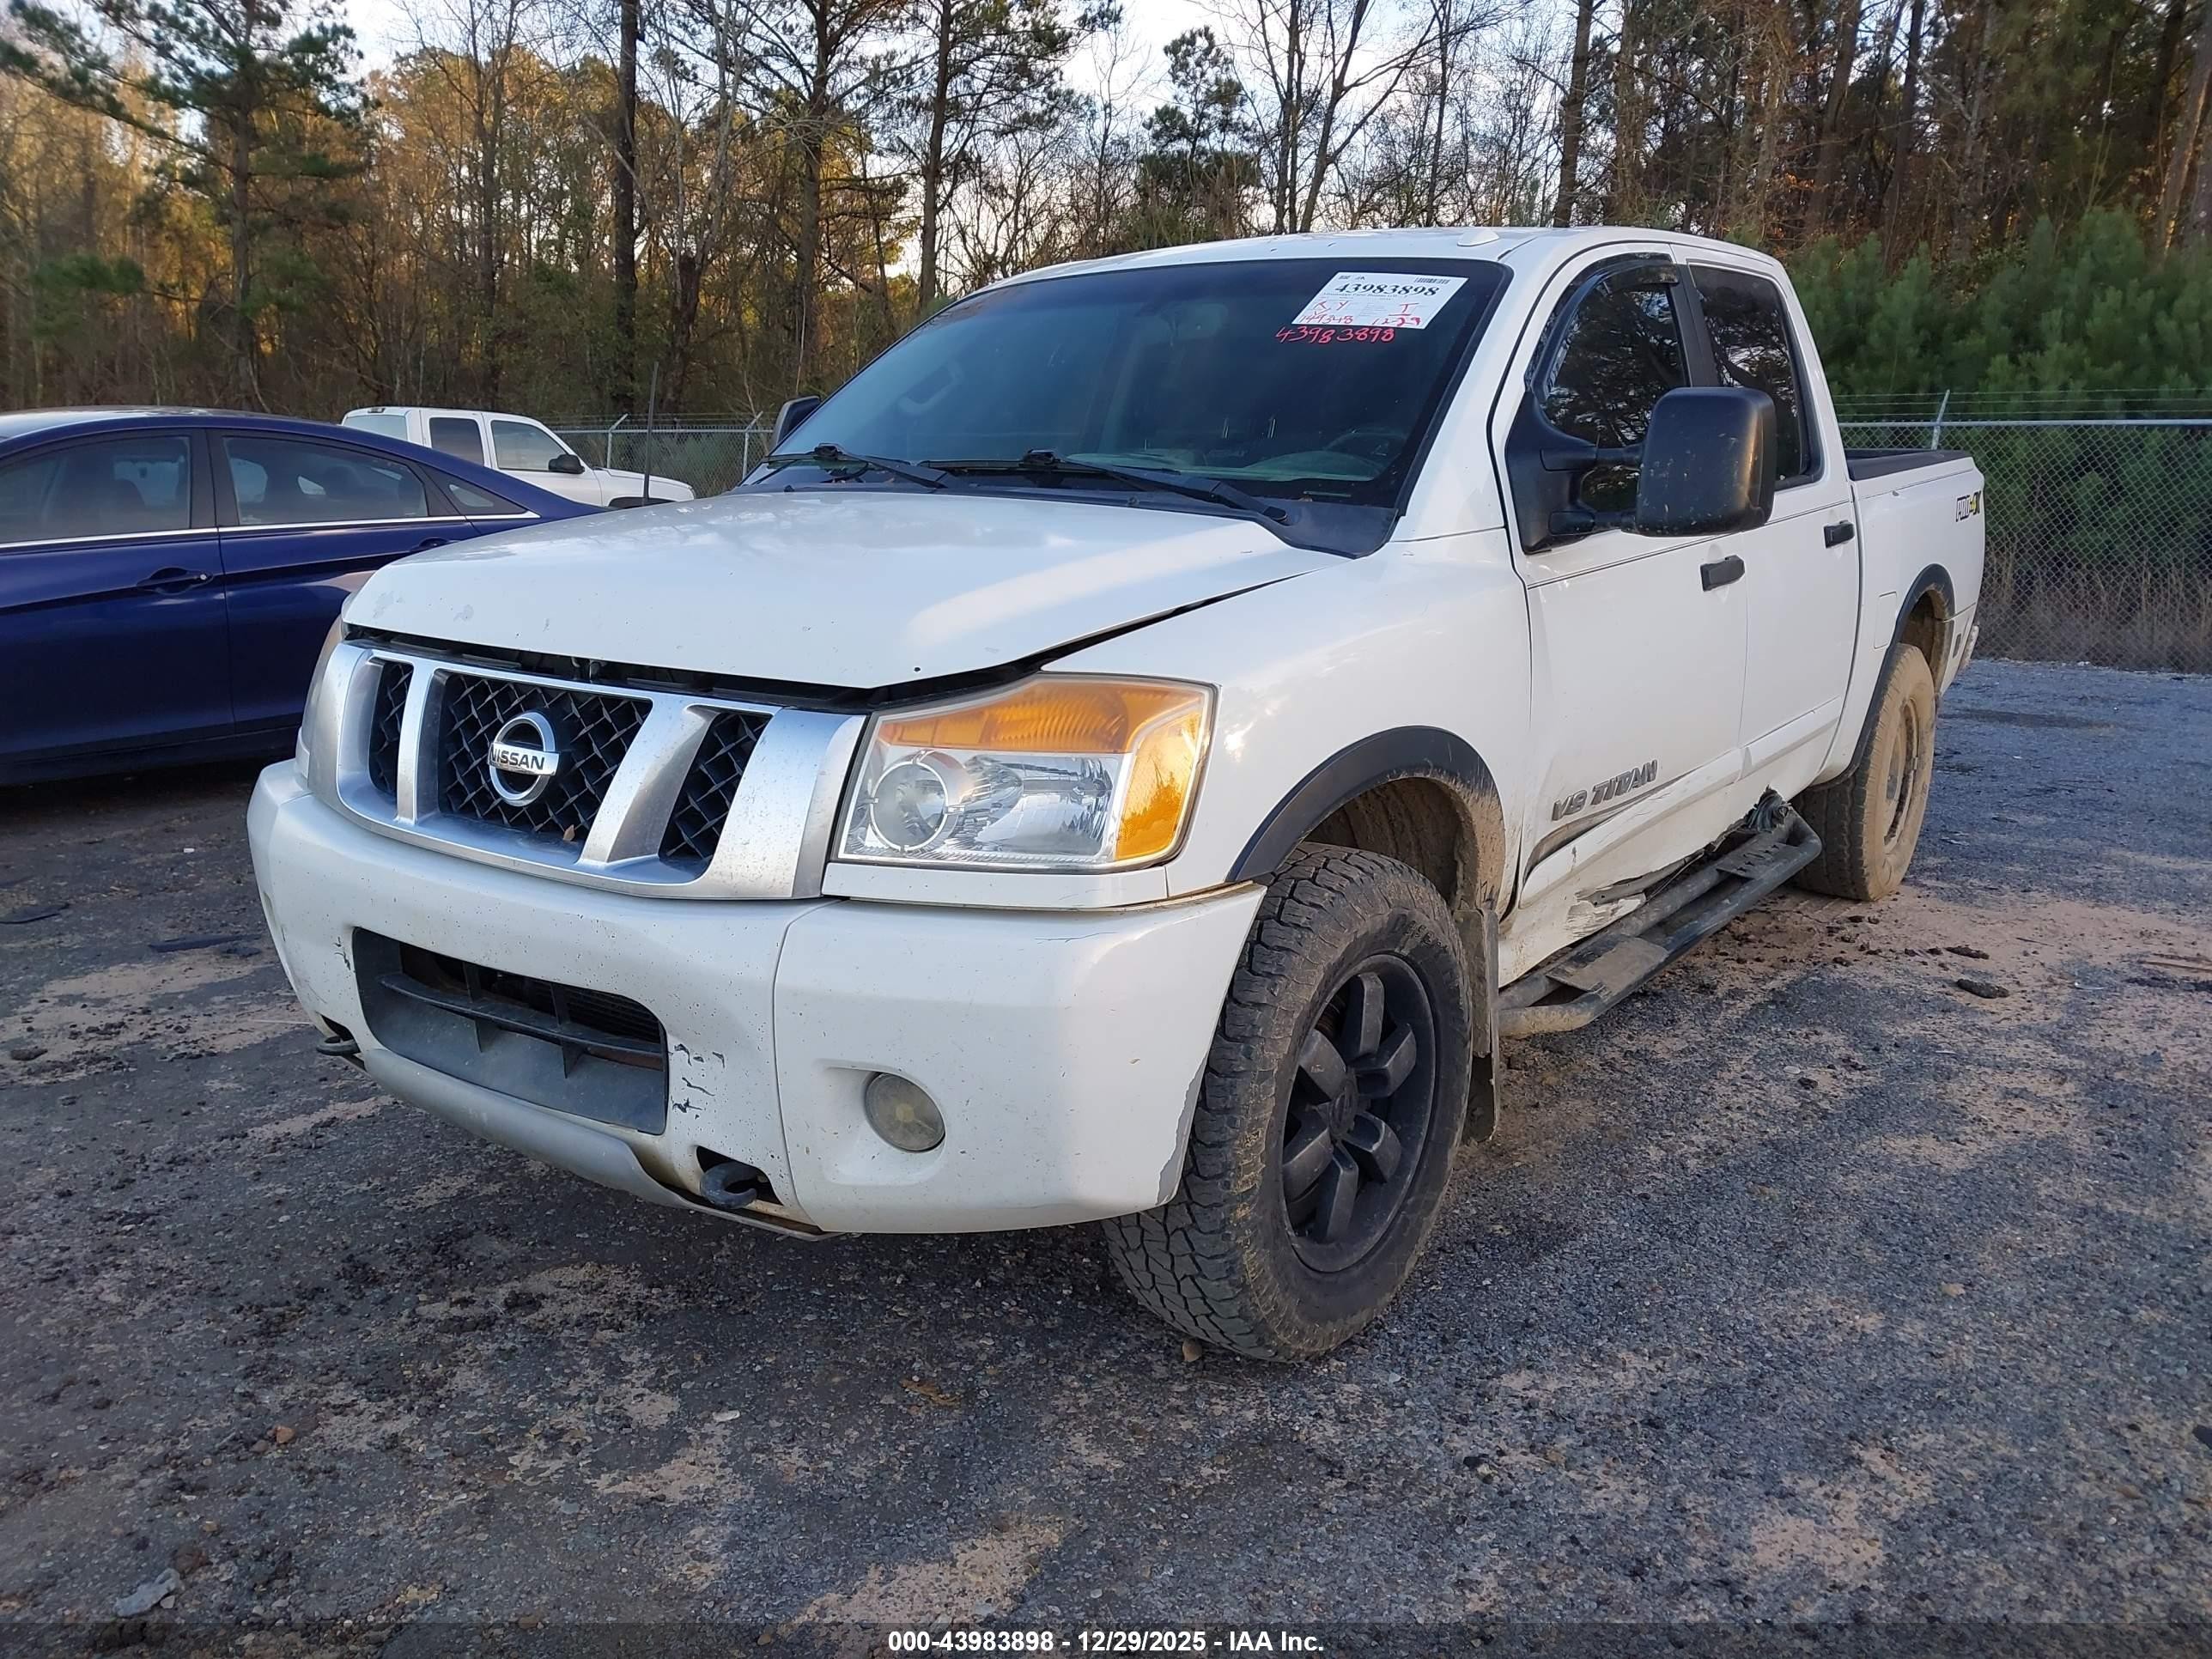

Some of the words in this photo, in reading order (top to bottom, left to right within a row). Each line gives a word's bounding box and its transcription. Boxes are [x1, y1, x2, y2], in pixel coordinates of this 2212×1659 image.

[1335, 283, 1440, 296] 43983898
[489, 746, 545, 770] NISSAN
[1552, 789, 1588, 821] V8
[1590, 759, 1658, 805] TITAN
